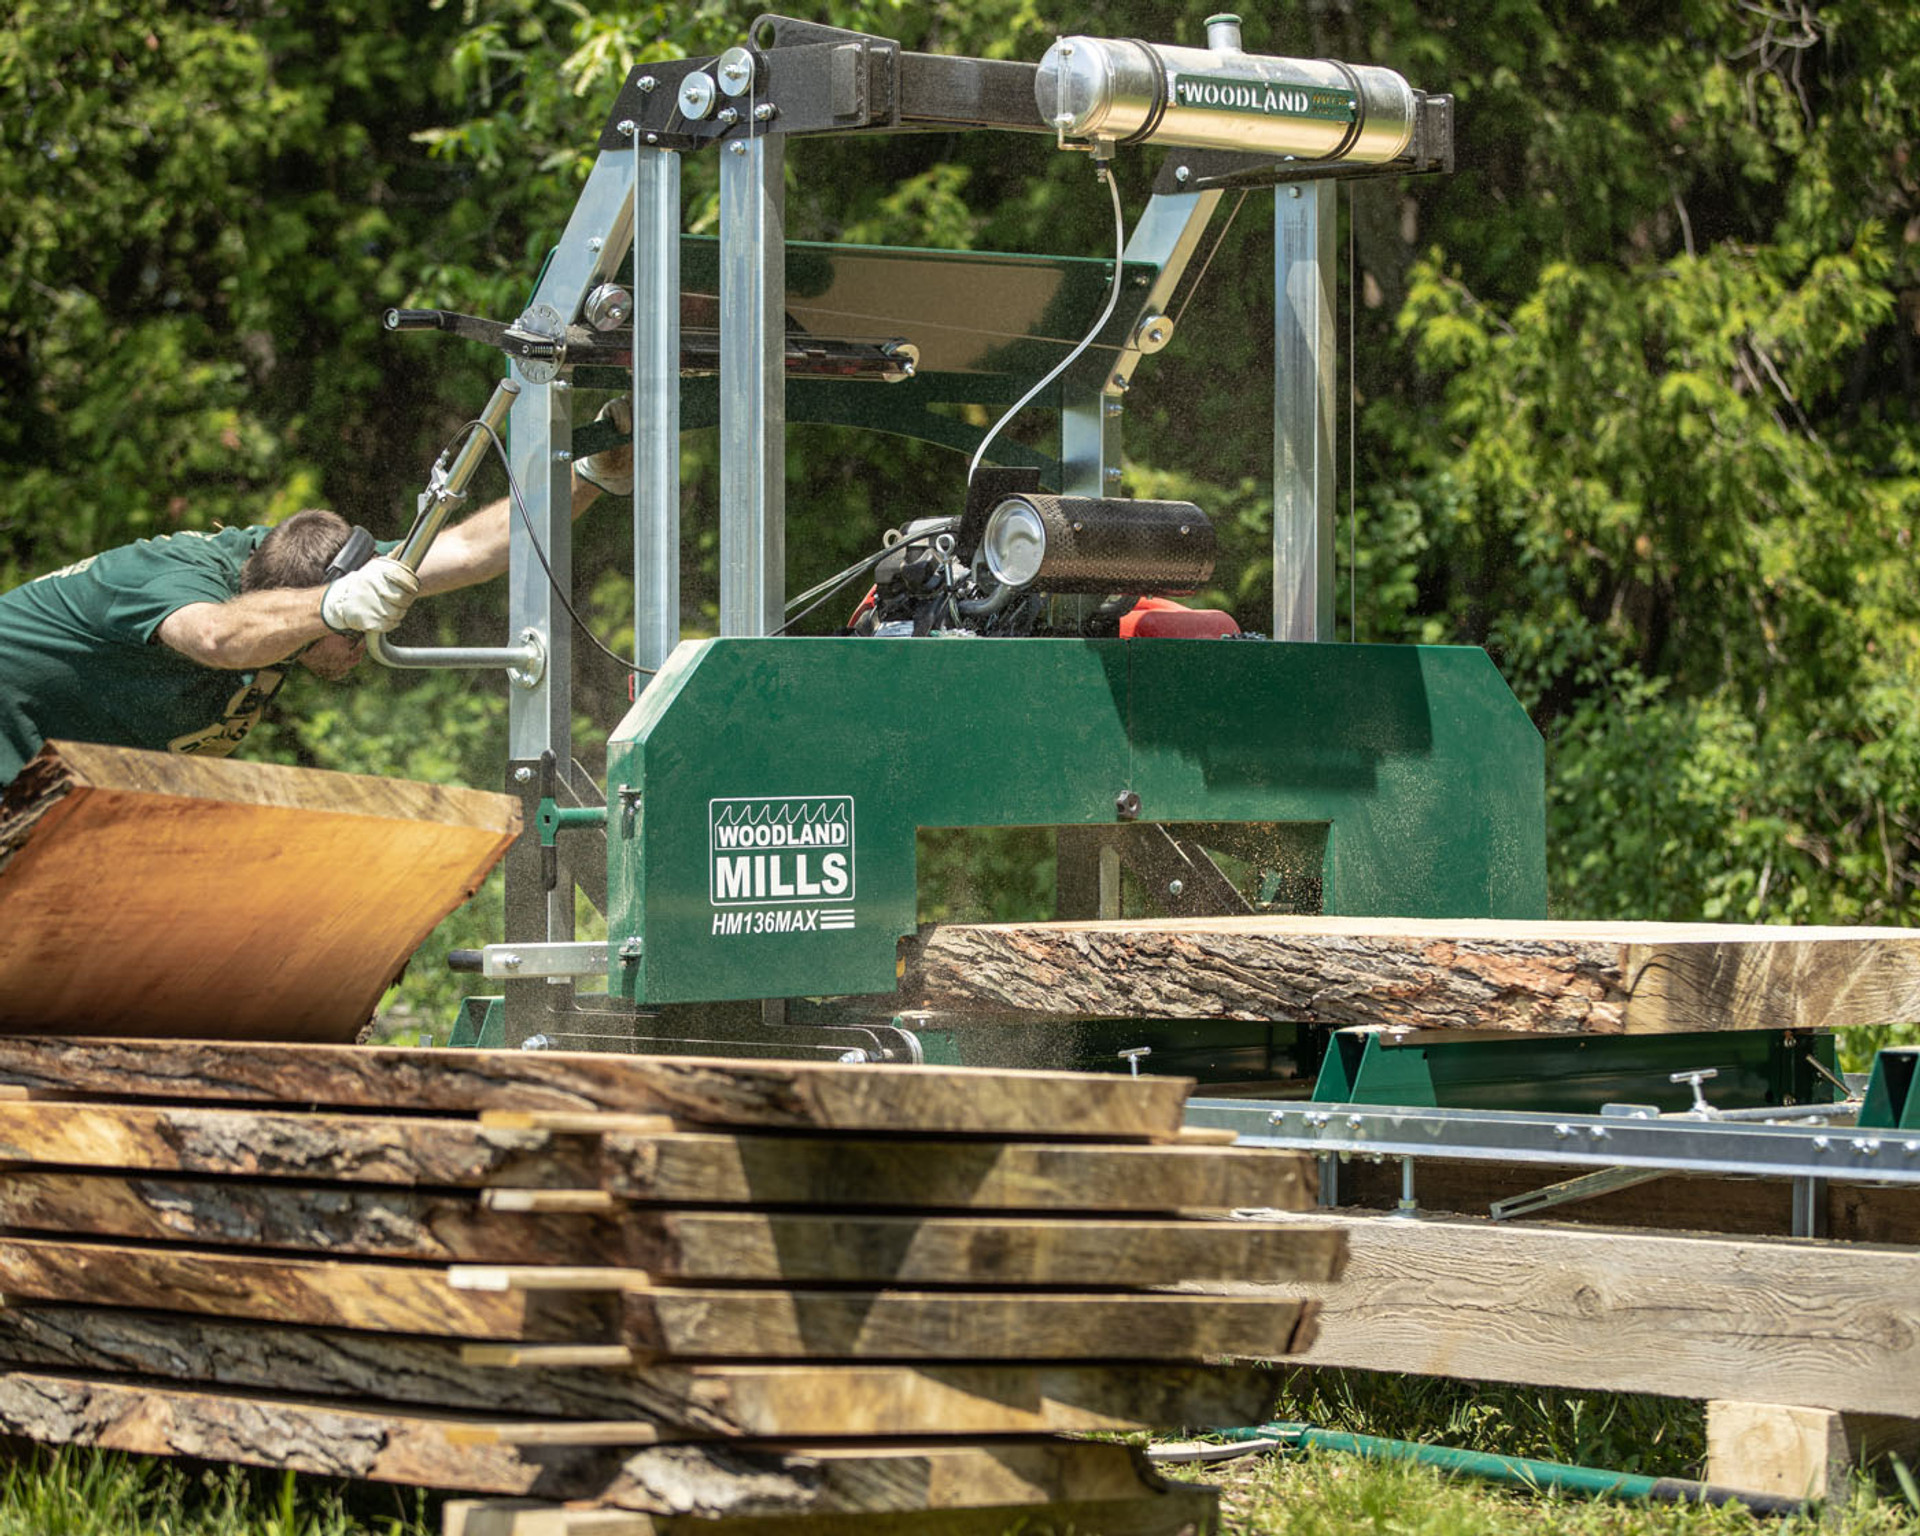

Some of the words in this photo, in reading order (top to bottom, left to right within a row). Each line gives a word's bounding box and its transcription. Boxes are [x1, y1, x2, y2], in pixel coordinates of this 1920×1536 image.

[1184, 81, 1308, 112] WOODLAND
[718, 823, 846, 847] WOODLAND
[716, 853, 848, 898] MILLS
[712, 909, 819, 935] HM136MAX
